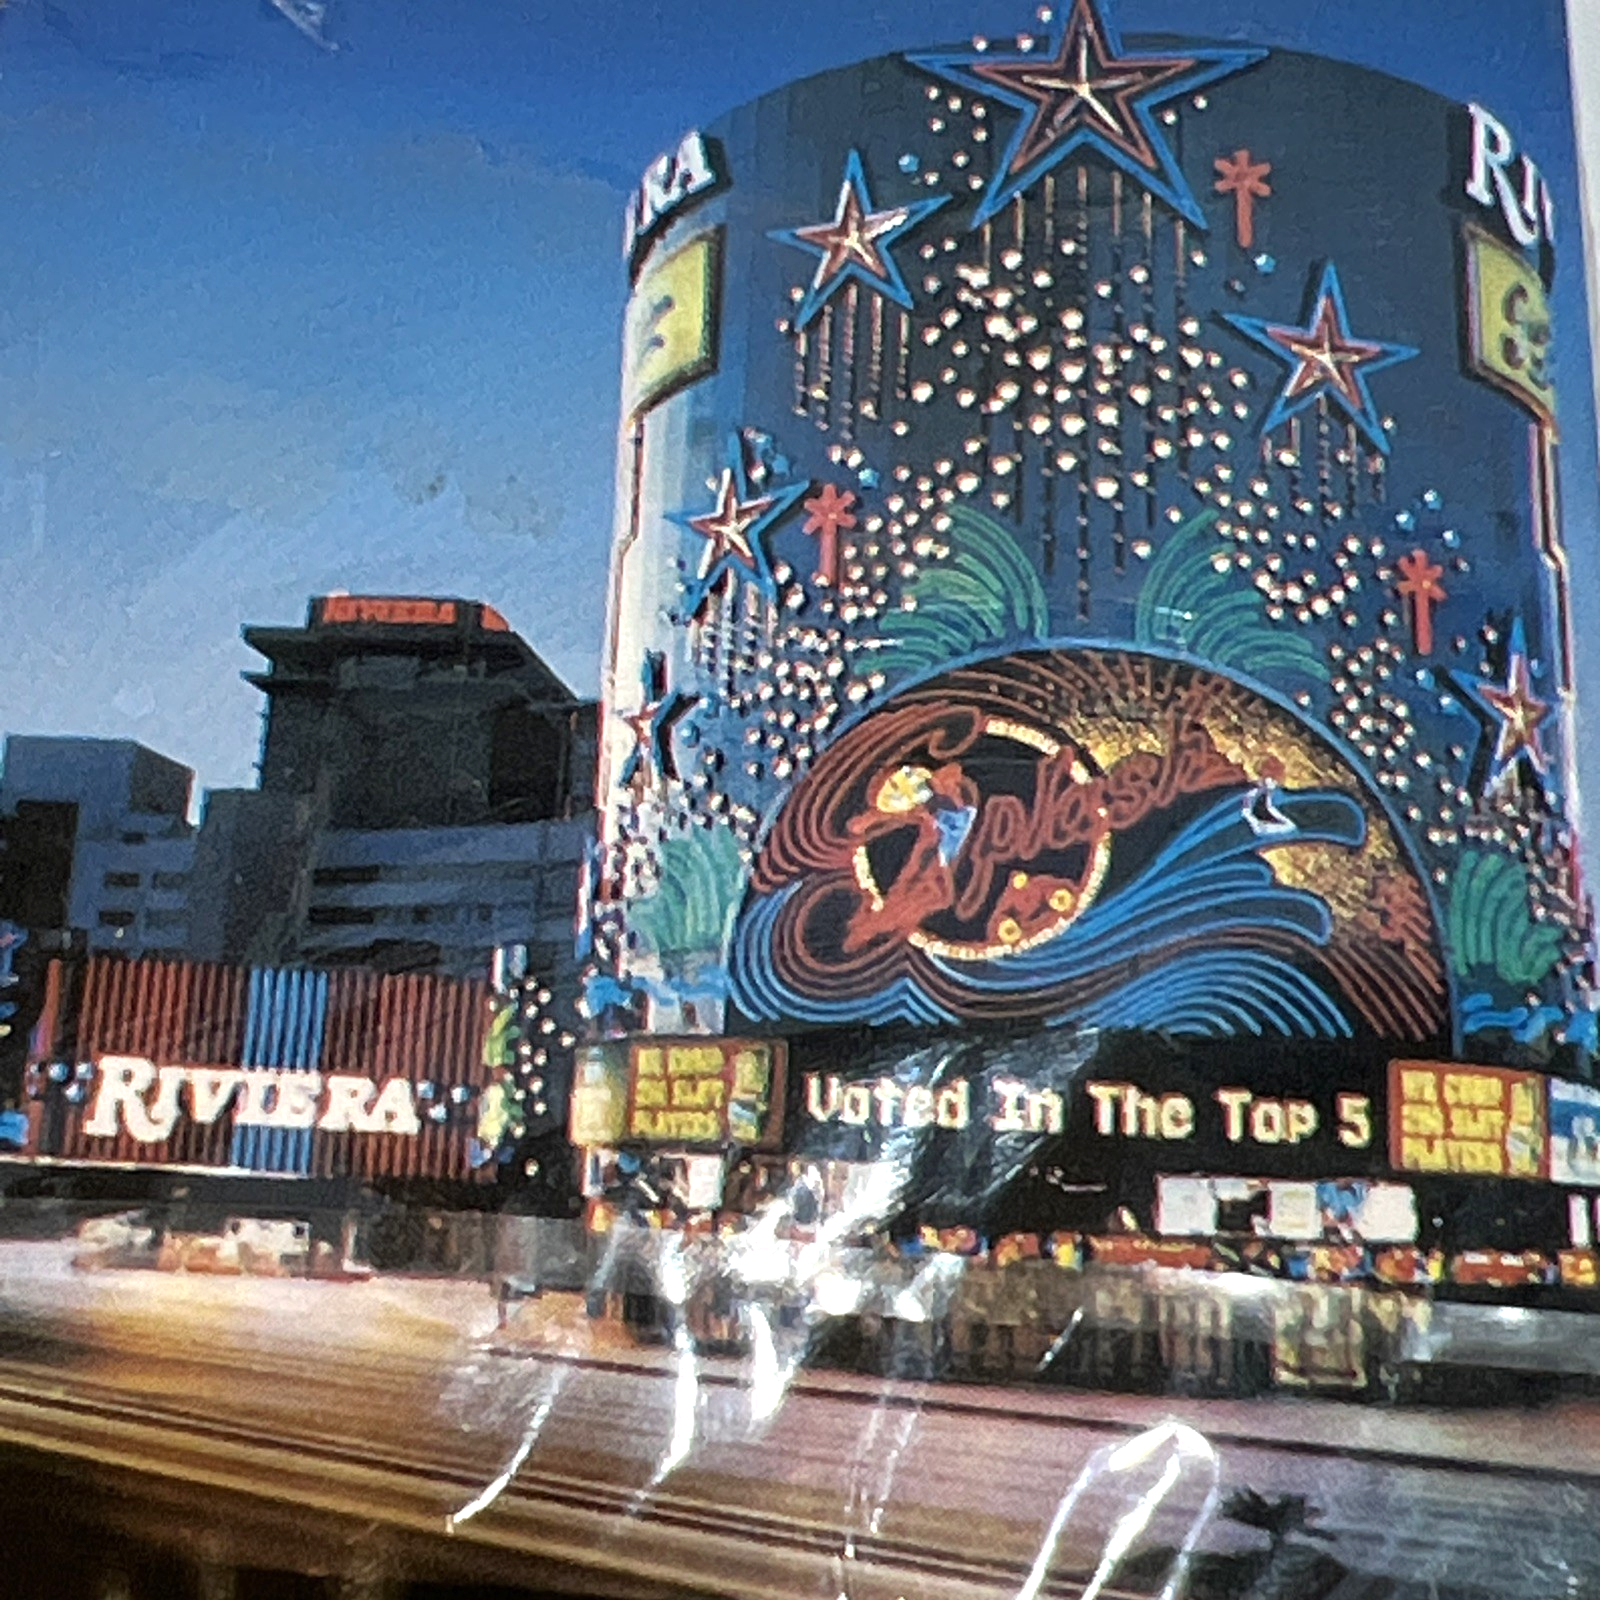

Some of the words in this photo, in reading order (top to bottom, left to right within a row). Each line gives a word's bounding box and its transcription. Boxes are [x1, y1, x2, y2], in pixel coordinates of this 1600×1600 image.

[83, 1054, 421, 1143] RIVIERA
[804, 1070, 971, 1131] Voted
[986, 1075, 1066, 1135] In
[1085, 1079, 1196, 1140] The
[1210, 1085, 1319, 1144] Top
[1335, 1091, 1372, 1149] 5
